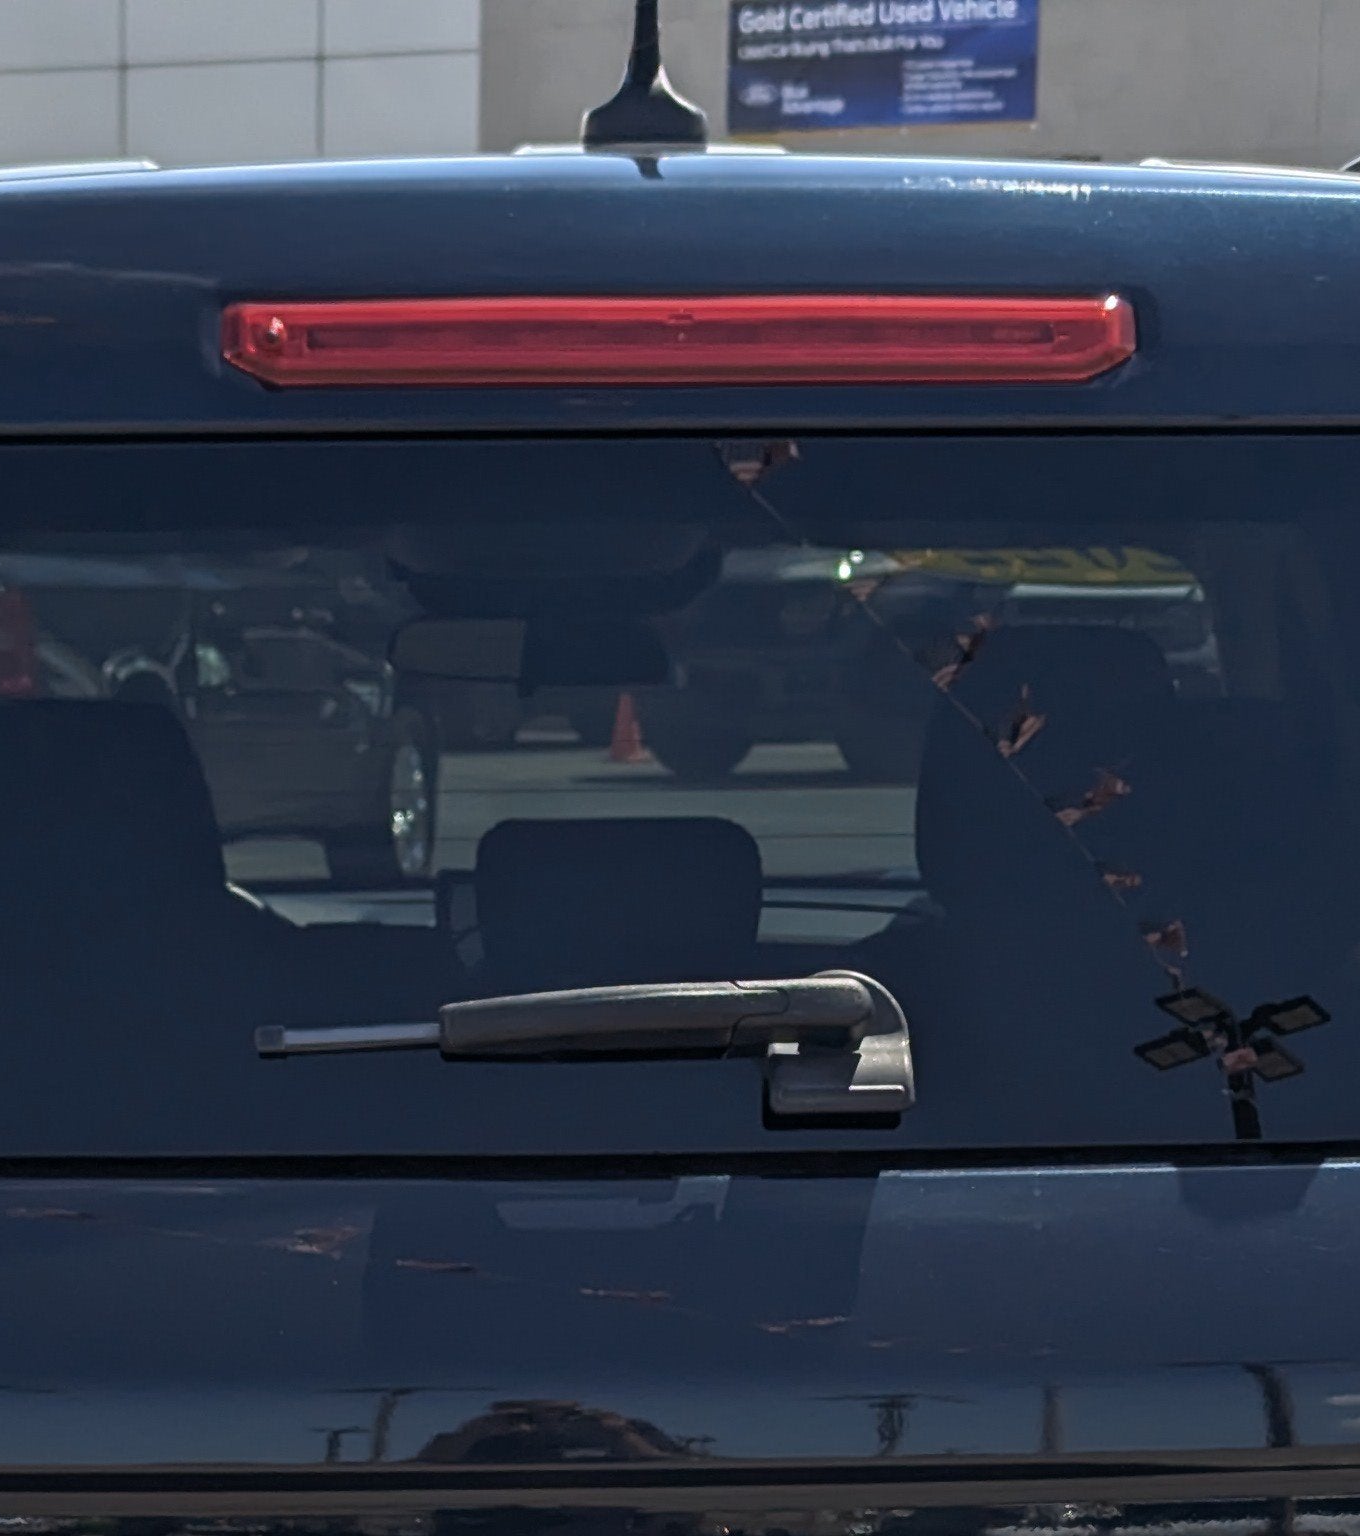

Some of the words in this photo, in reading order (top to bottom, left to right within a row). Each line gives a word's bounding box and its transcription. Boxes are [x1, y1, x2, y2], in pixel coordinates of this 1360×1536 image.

[739, 8, 785, 33] Gold
[789, 3, 875, 30] Certified
[879, 0, 934, 24] Used
[939, 0, 1018, 21] Vehicle
